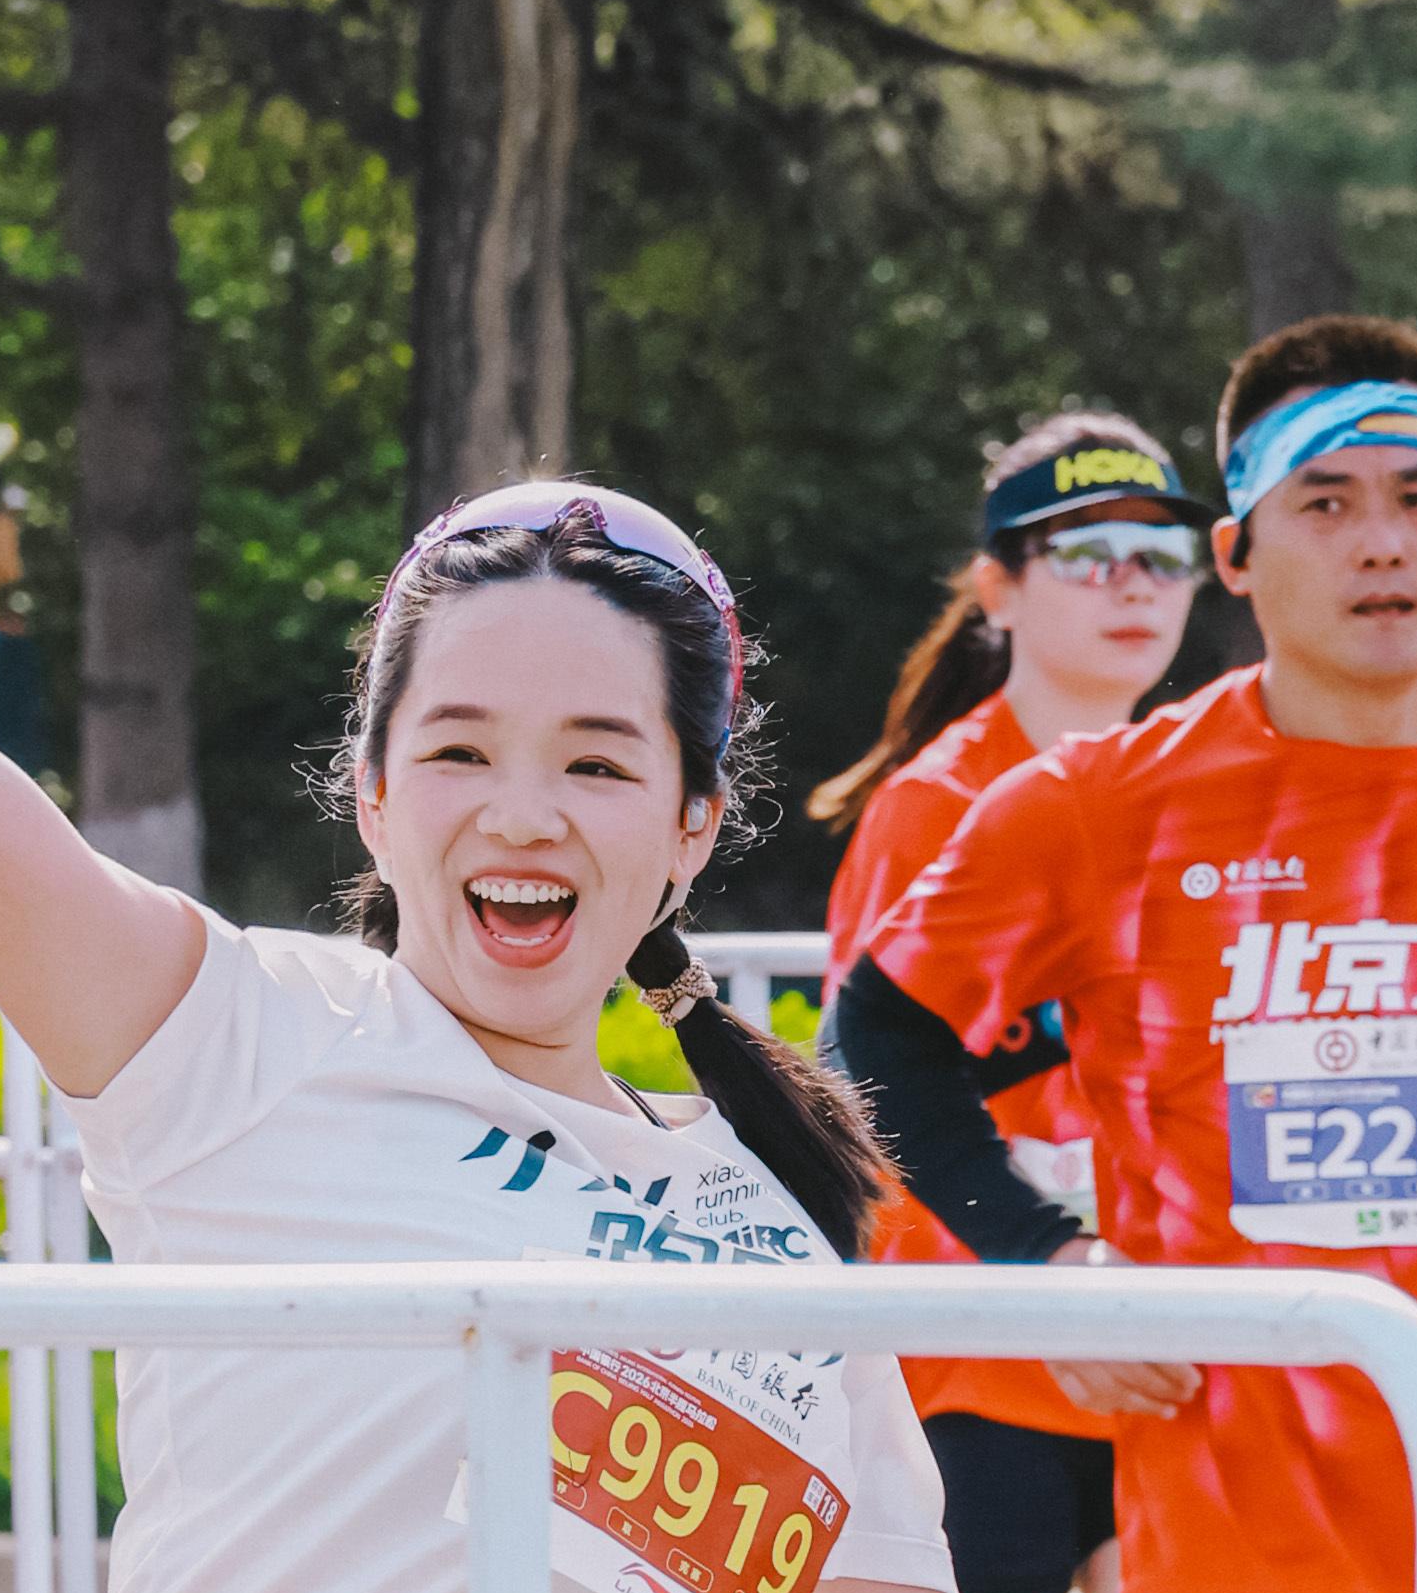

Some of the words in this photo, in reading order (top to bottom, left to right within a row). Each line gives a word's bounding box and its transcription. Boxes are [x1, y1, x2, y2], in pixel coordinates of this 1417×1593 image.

[1055, 449, 1168, 493] HOKA
[696, 1163, 745, 1190] xiao
[697, 1368, 736, 1401] BANK
[739, 1394, 758, 1413] OF
[760, 1407, 802, 1446] CHINA
[820, 1494, 838, 1526] 18
